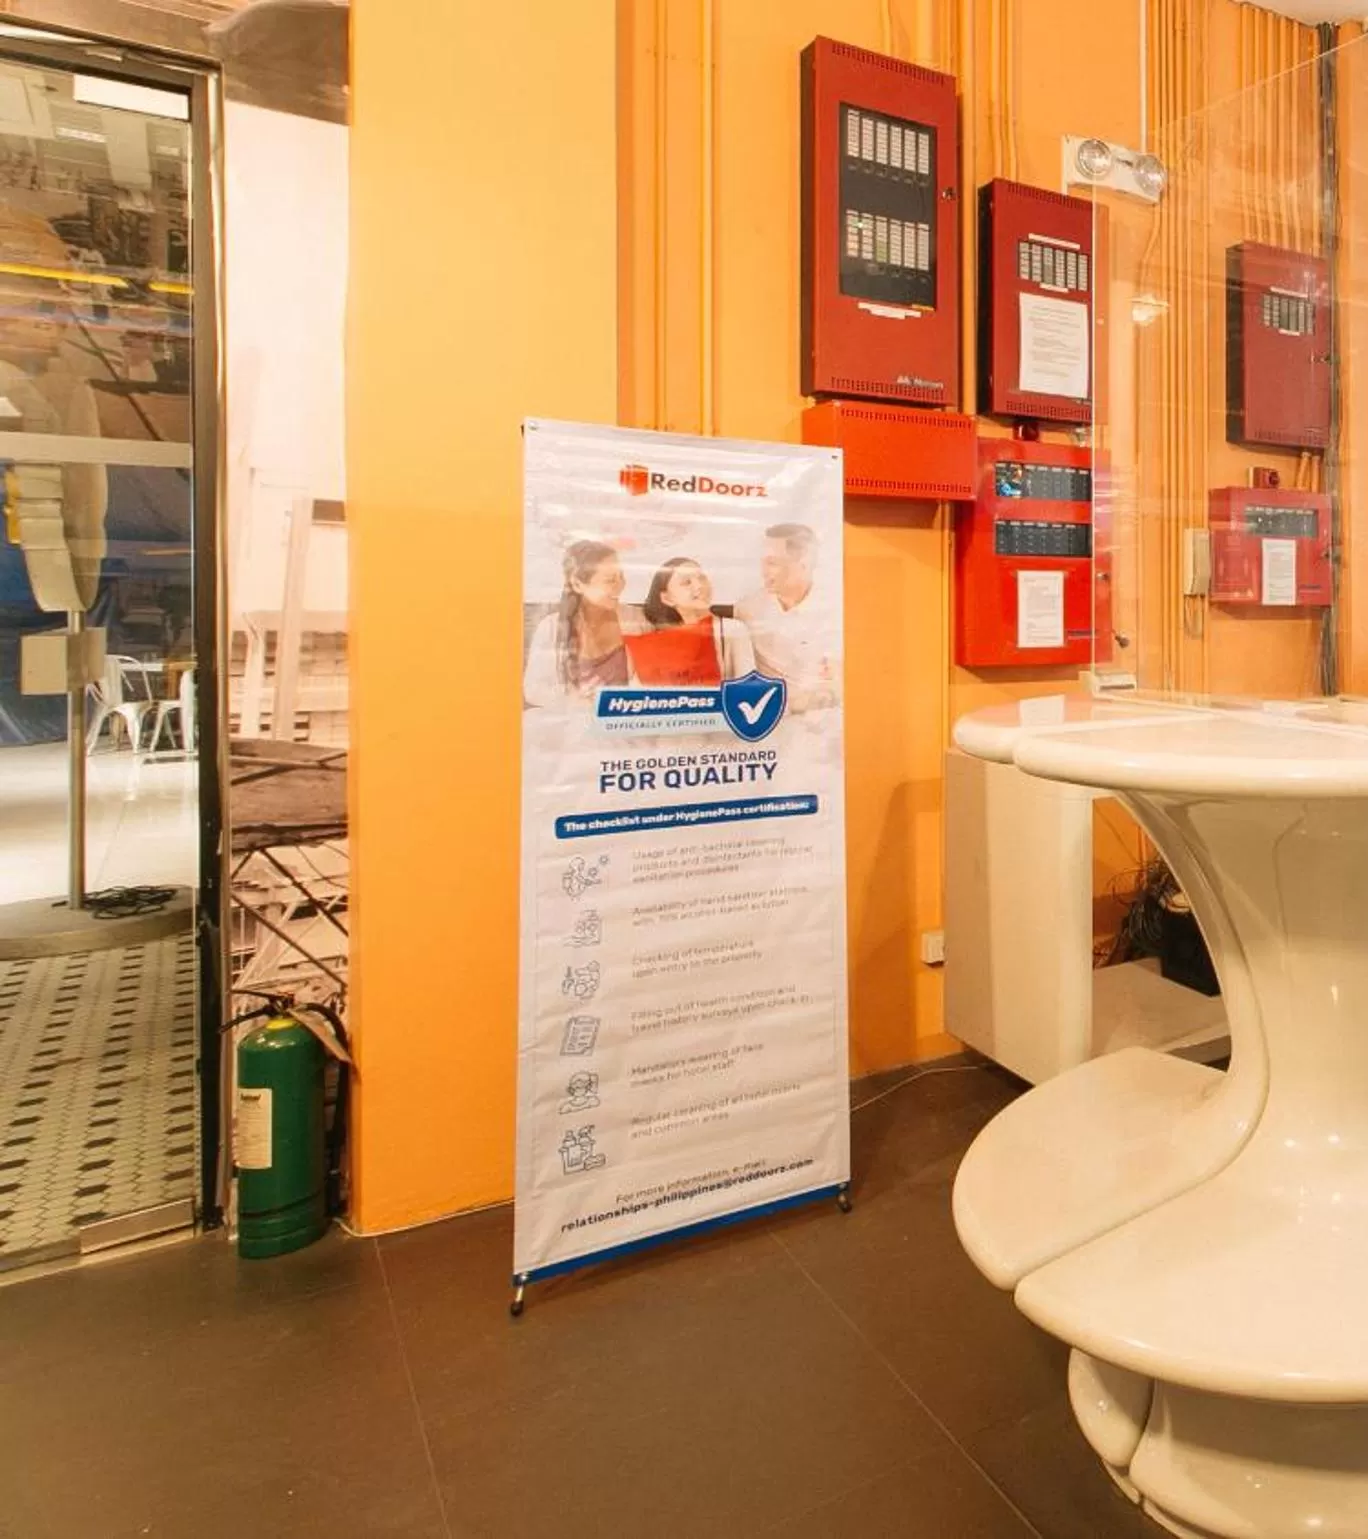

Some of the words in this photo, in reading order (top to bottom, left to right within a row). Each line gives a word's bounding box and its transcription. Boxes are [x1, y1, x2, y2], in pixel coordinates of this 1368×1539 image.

[651, 472, 768, 497] RedDoorz
[608, 696, 717, 713] HygienePass
[601, 759, 633, 773] THE
[636, 755, 697, 770] GOLDEN
[700, 750, 777, 766] STANDARD
[600, 770, 656, 794] FOR
[663, 762, 778, 789] QUALITY
[564, 821, 586, 833] The
[589, 815, 641, 831] checklist
[642, 812, 675, 825] under
[676, 806, 742, 824] HygienePass
